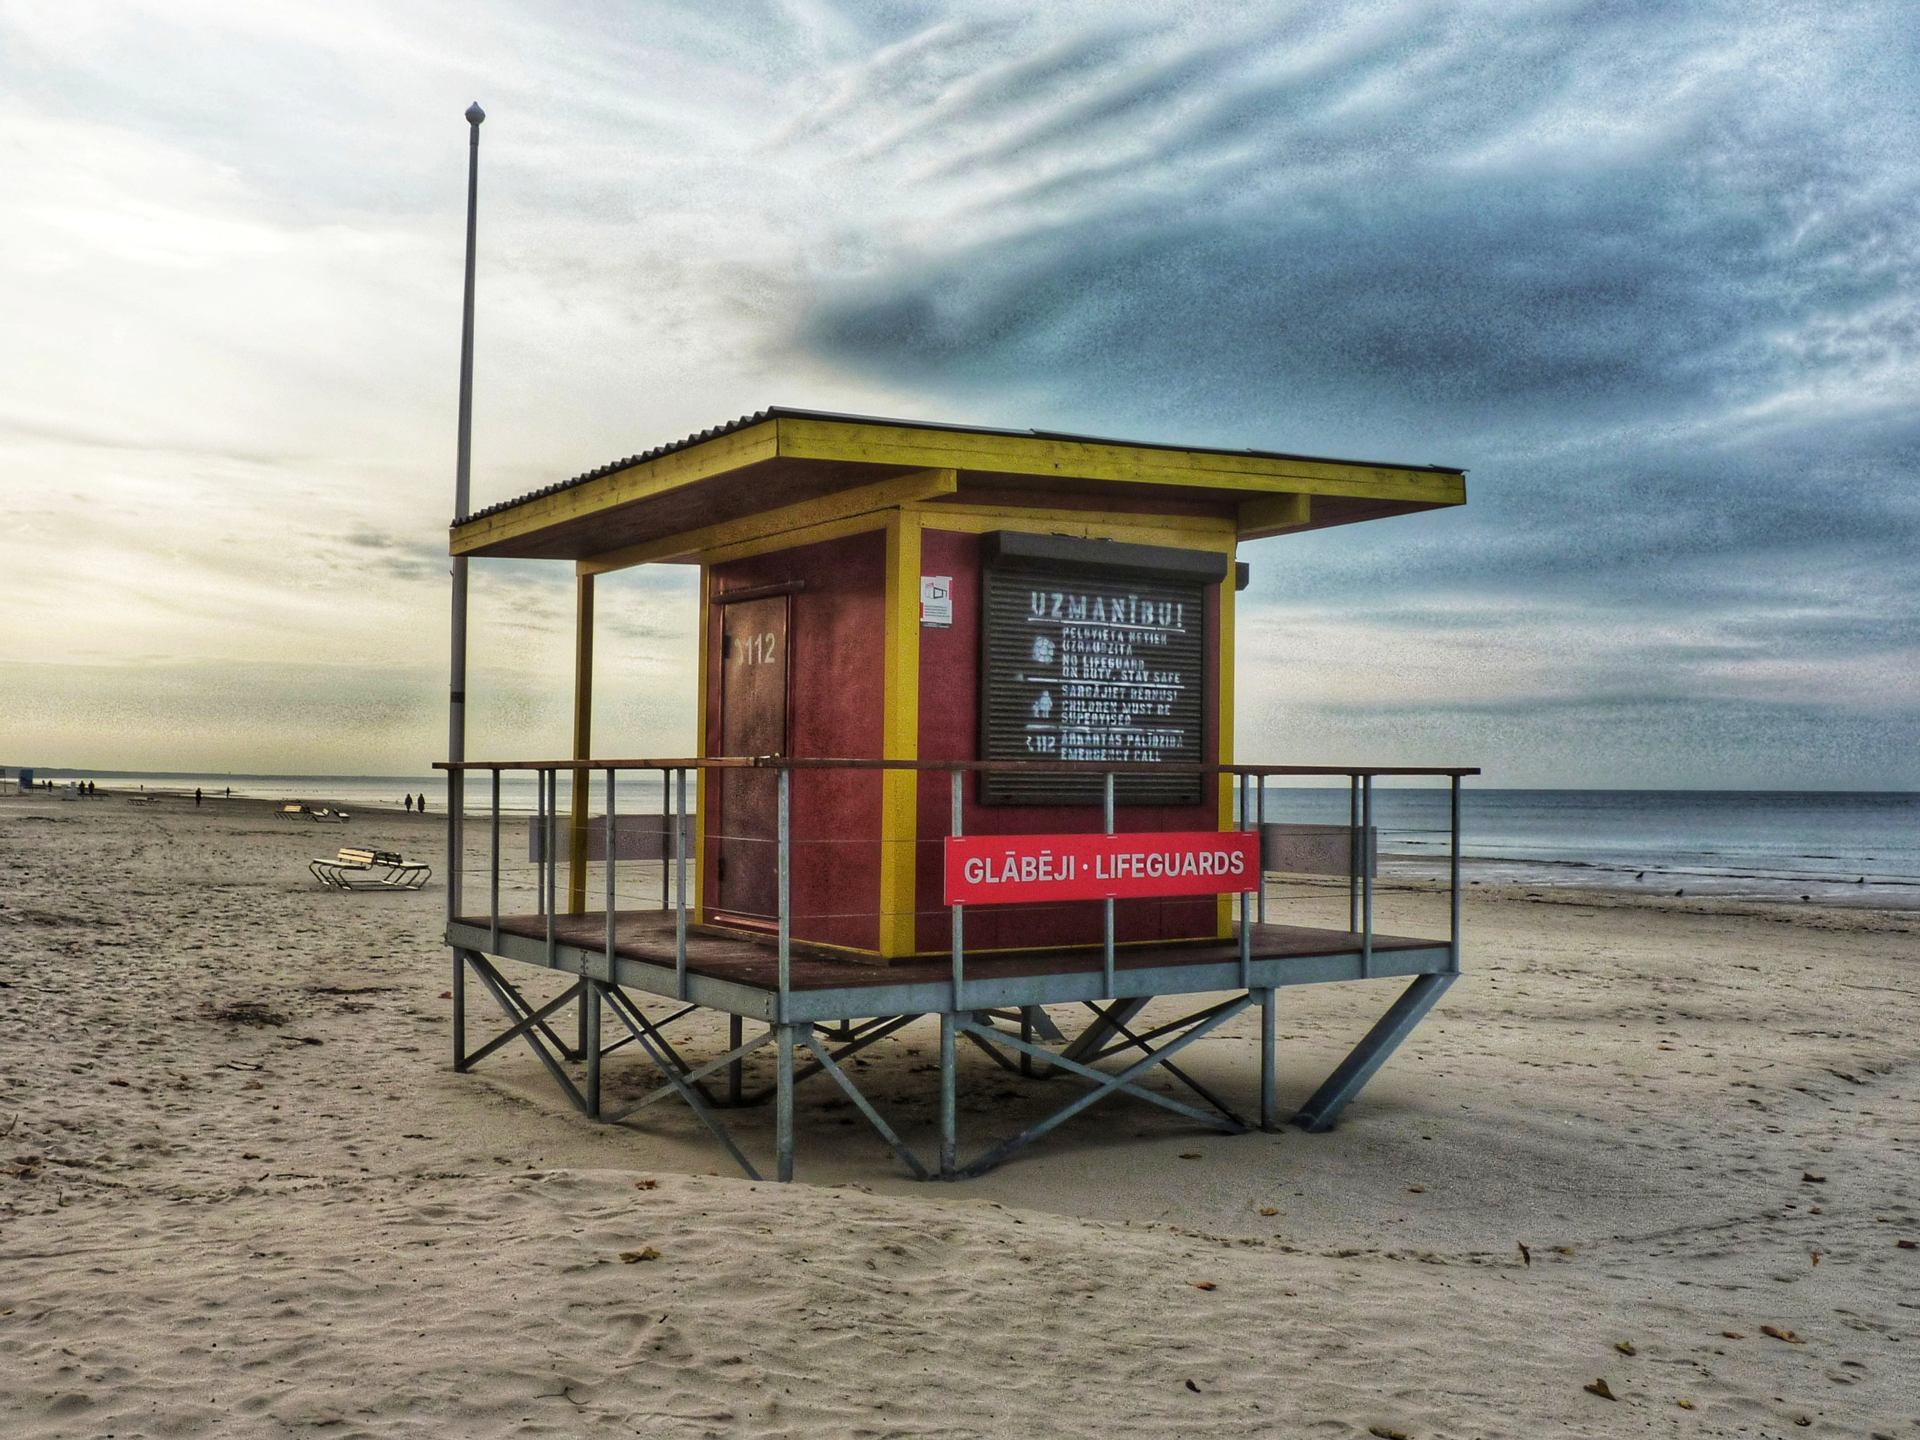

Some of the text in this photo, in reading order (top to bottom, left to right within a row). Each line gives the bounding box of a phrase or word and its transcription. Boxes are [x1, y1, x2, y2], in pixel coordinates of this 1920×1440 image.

[1031, 591, 1183, 628] UZMANĪBU!
[1062, 654, 1145, 670] NO LIFEGUARD
[1062, 666, 1078, 678] ON
[1121, 670, 1149, 682] STAY
[1154, 672, 1180, 684] SAFE
[1061, 700, 1170, 716] CHILDREN MUST BE
[1061, 712, 1132, 725] SUPERVISED
[1036, 735, 1056, 752] 112
[1061, 747, 1161, 762] EMERGENCY CALL
[964, 850, 1245, 884] GLĀBĒJI LIFEGUARDS
